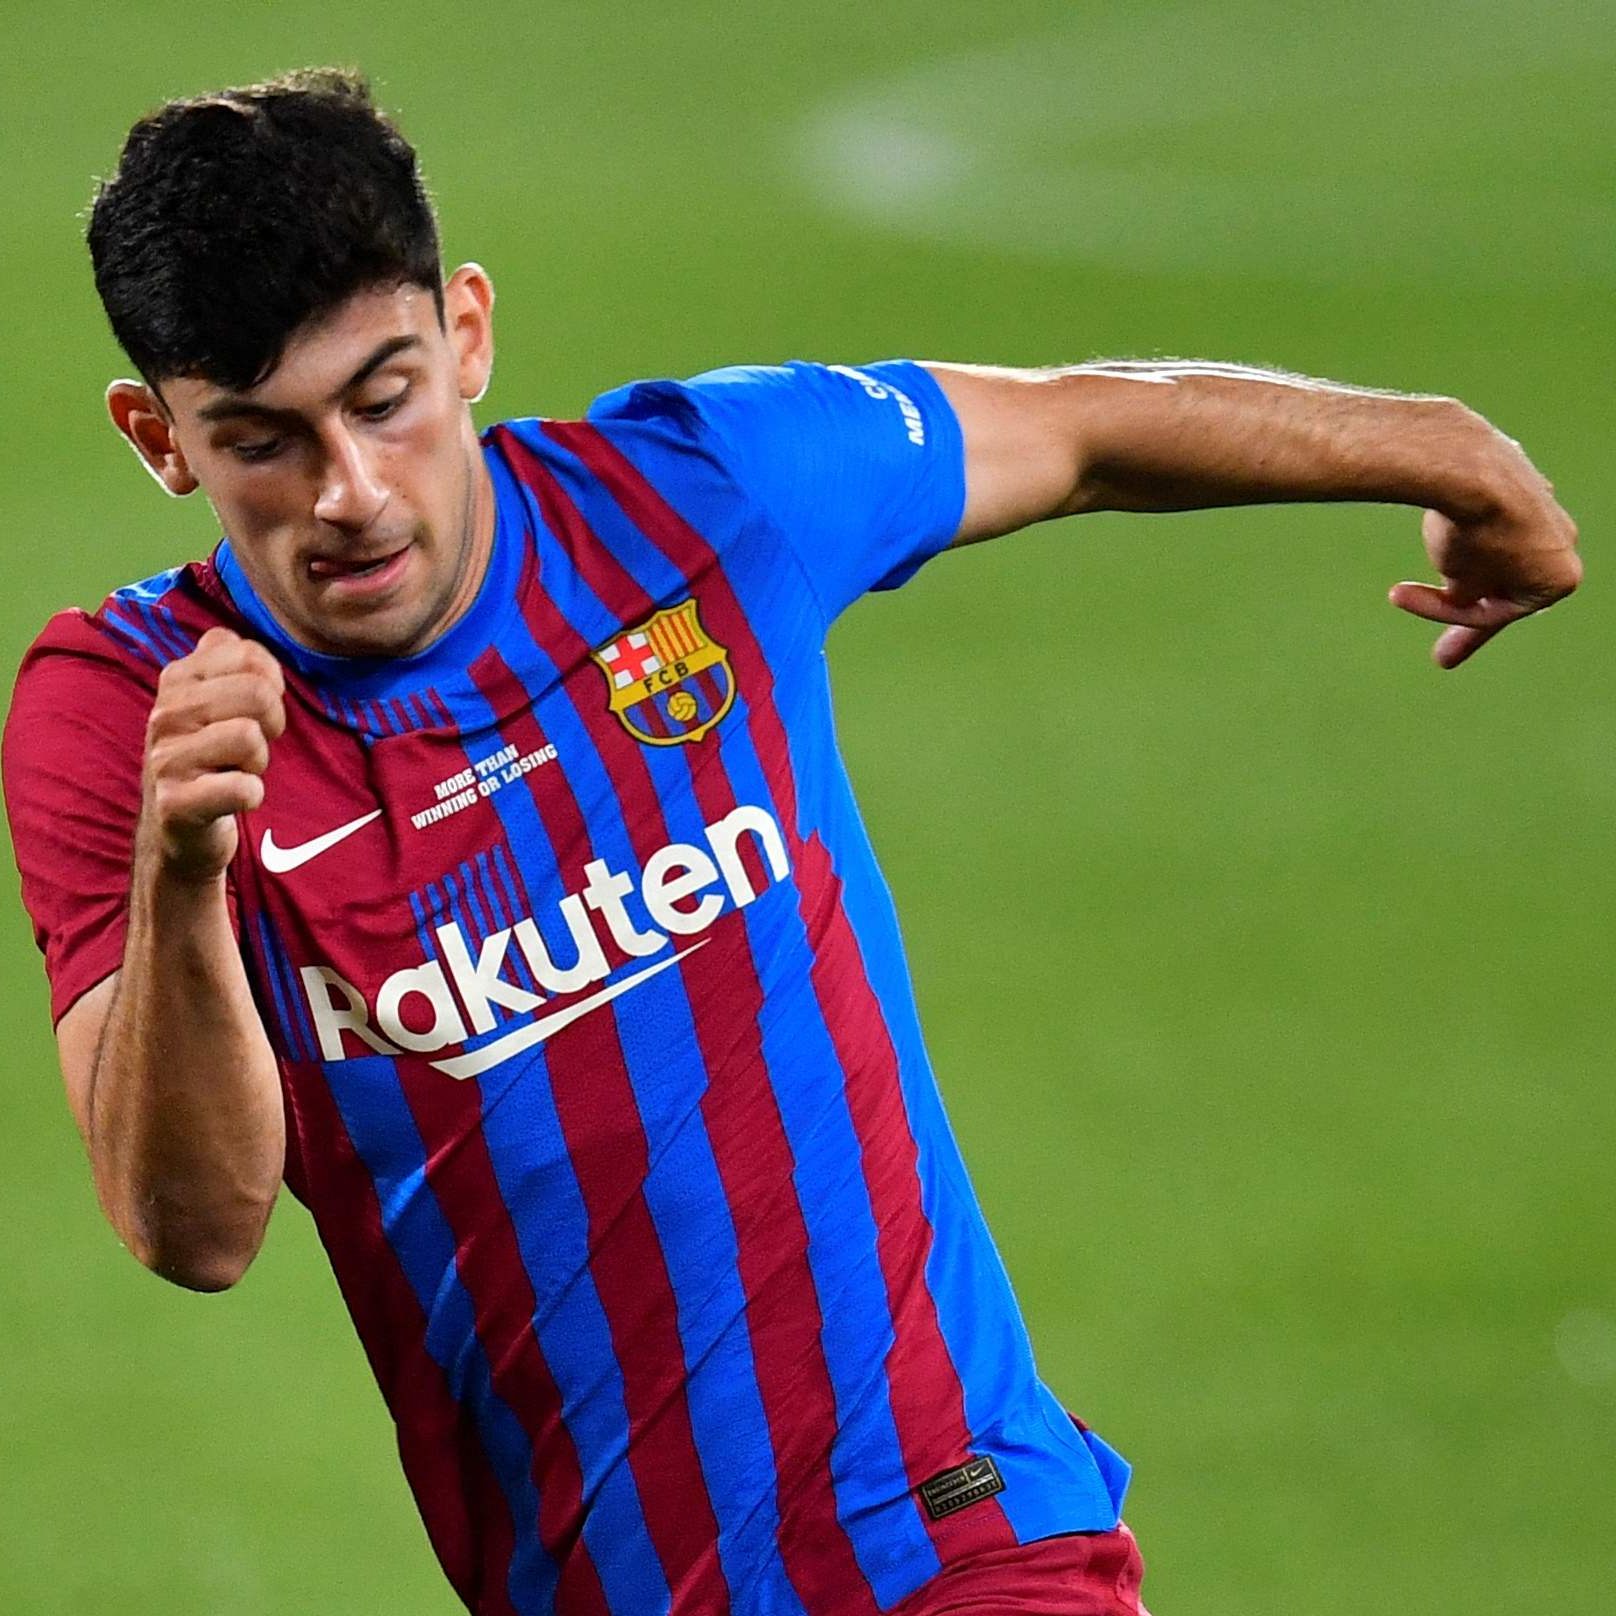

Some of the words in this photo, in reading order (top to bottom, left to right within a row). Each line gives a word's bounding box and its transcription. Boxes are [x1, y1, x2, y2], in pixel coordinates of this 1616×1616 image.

[643, 662, 689, 694] FCB
[410, 788, 478, 830] WINNING
[477, 776, 501, 797] OR
[500, 743, 558, 784] LOSING
[434, 767, 476, 800] MORE
[474, 743, 519, 777] THAN
[300, 805, 790, 1062] Rakuten
